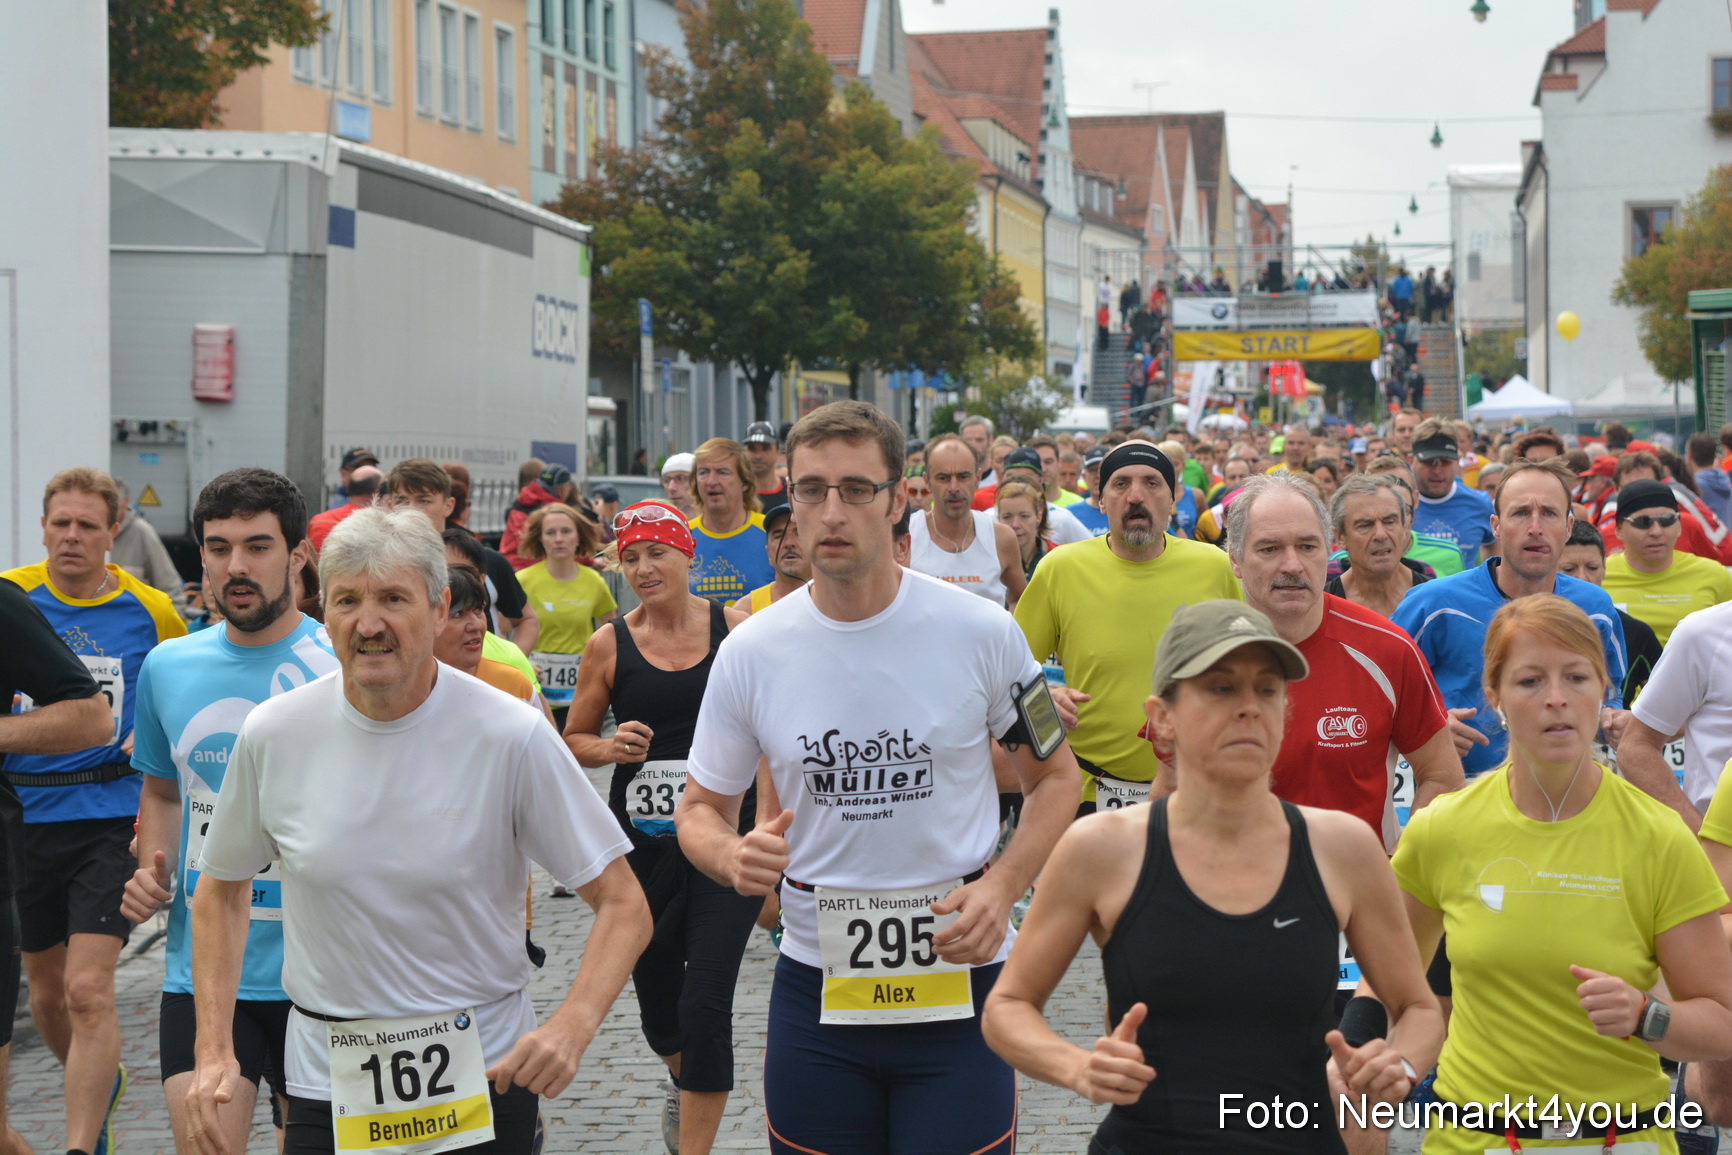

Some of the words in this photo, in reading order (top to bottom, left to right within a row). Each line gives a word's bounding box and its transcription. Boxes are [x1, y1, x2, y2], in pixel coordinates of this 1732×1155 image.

[532, 294, 578, 364] BOCK
[1240, 335, 1311, 354] START
[538, 667, 577, 687] 148
[98, 680, 114, 708] 5
[1330, 716, 1349, 730] ASV
[194, 747, 231, 764] and
[803, 729, 918, 774] Sport
[813, 768, 927, 794] Müller
[814, 797, 832, 807] Inh.
[836, 796, 886, 807] Andreas
[891, 789, 933, 803] Winter
[192, 801, 215, 815] PAR
[842, 809, 893, 822] Neumarkt
[251, 888, 266, 903] er
[819, 898, 865, 911] PARTL
[869, 895, 938, 910] Neumarkt
[847, 916, 938, 969] 295
[828, 966, 833, 975] B
[873, 984, 916, 1004] Alex
[331, 1035, 374, 1048] PARTL
[376, 1021, 449, 1045] Neumarkt
[360, 1043, 455, 1105] 162
[339, 1106, 345, 1114] B
[369, 1109, 459, 1142] Bernhard
